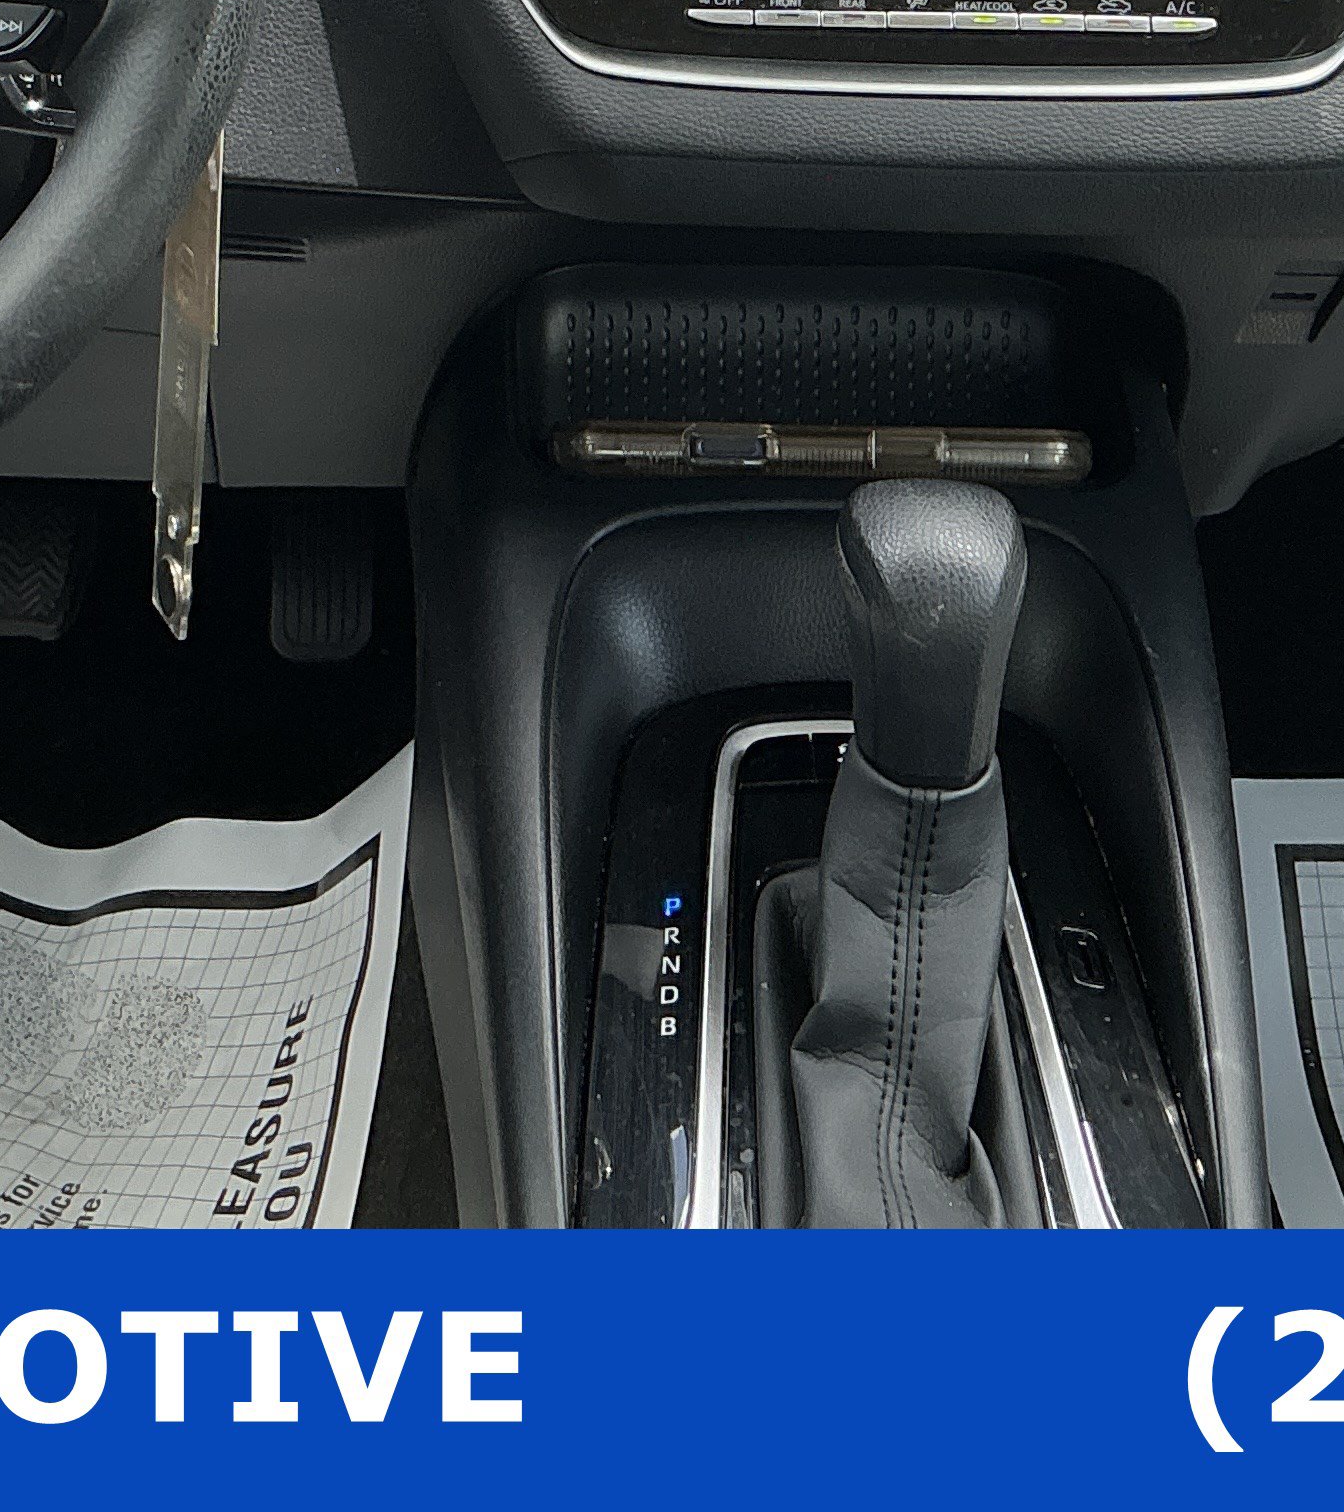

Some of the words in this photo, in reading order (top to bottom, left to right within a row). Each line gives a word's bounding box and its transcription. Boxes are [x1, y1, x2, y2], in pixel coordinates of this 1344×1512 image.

[839, 0, 867, 9] REAR
[955, 0, 1016, 12] HEAT/COOL
[1166, 1, 1196, 15] A/C
[665, 898, 681, 917] P
[664, 926, 681, 945] R
[661, 955, 681, 975] N
[660, 986, 679, 1005] D
[660, 1016, 677, 1036] B
[0, 1173, 41, 1206] for
